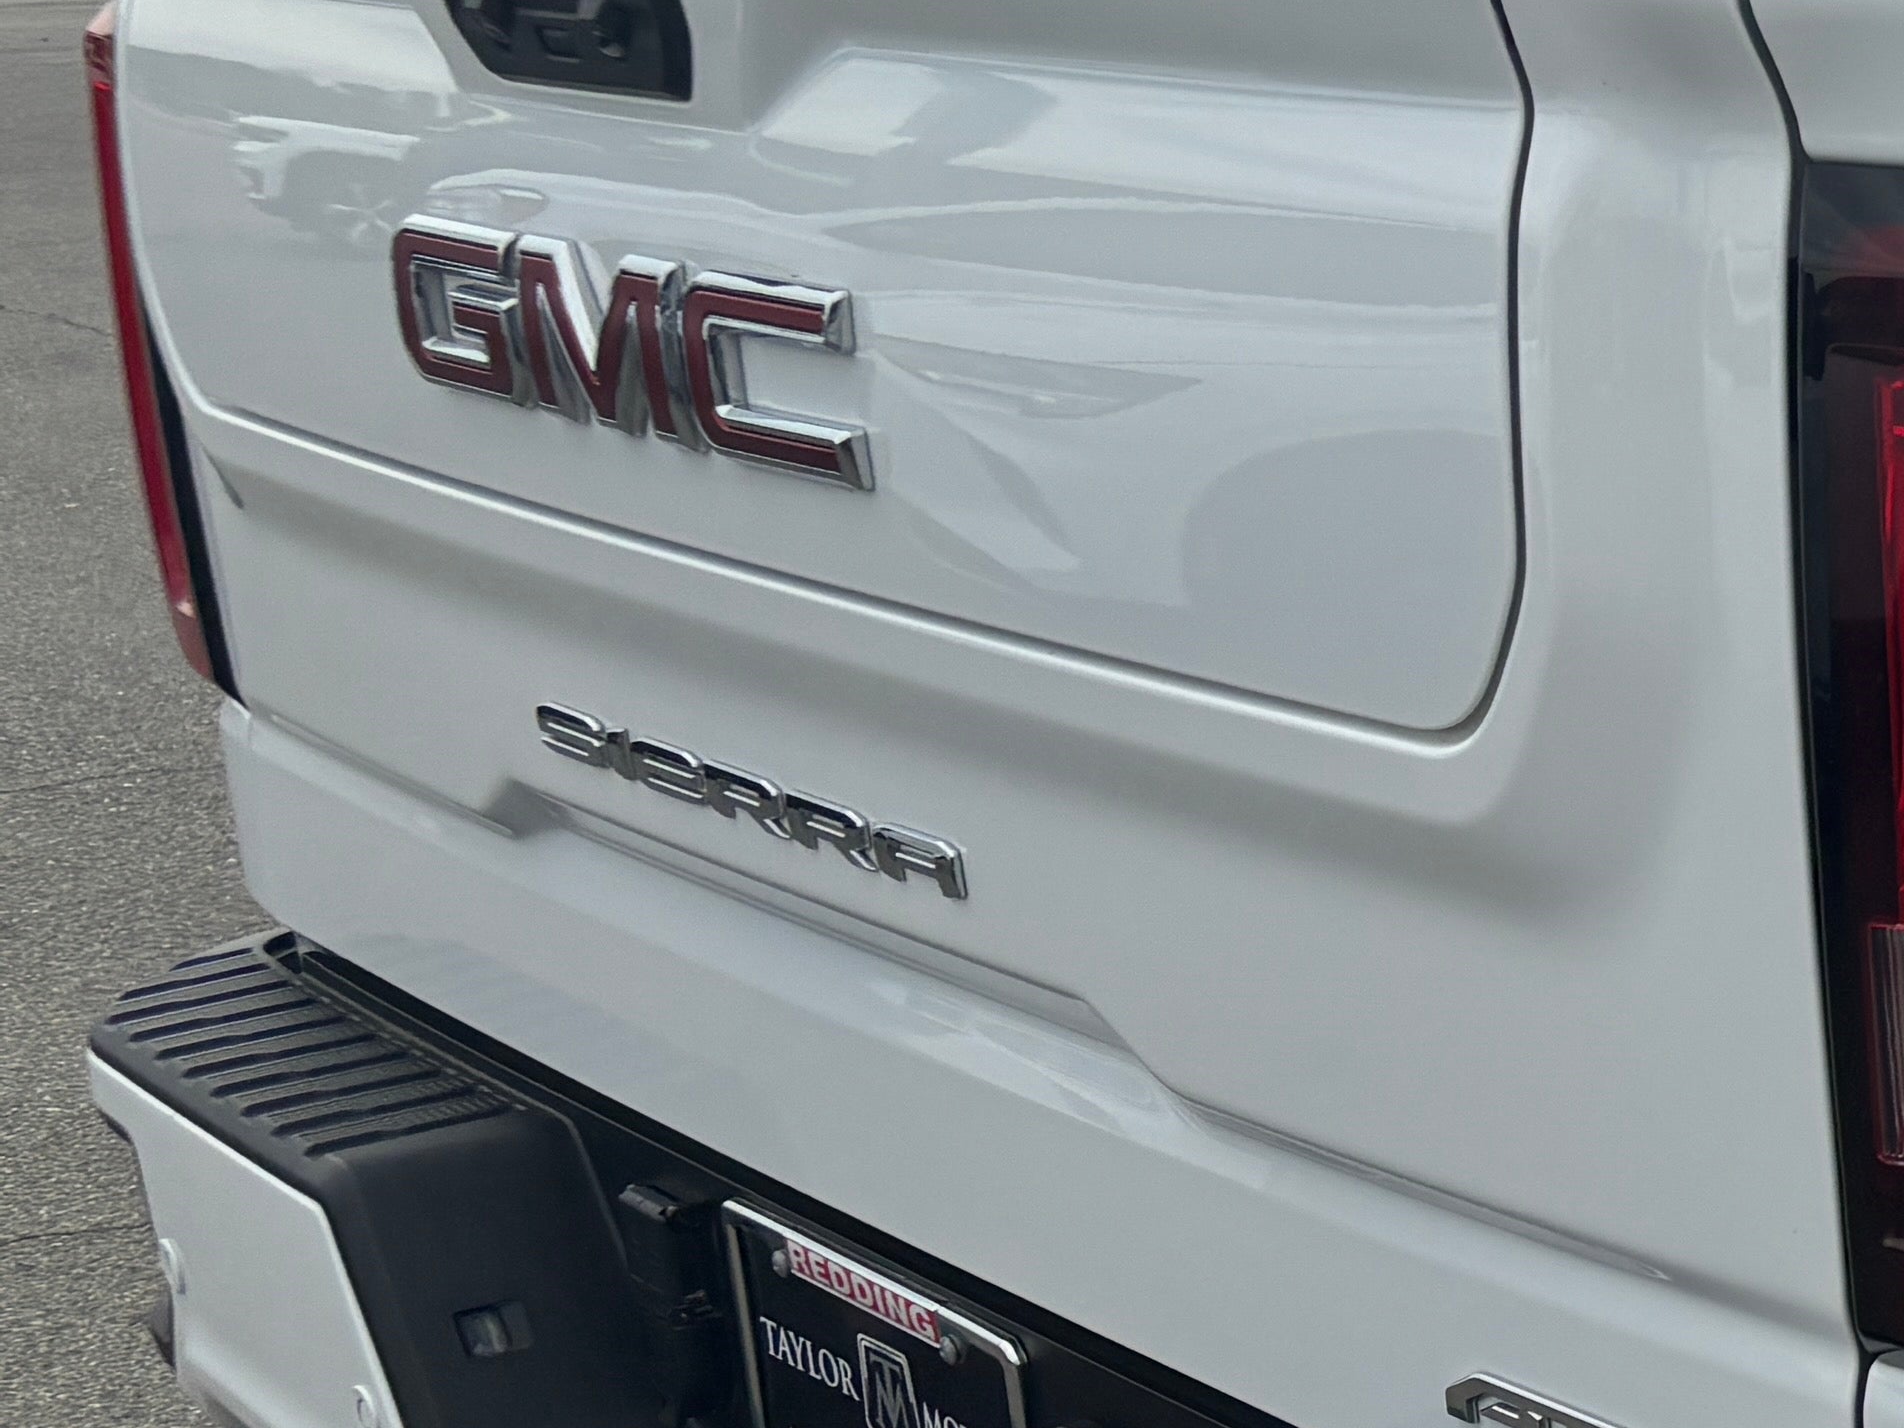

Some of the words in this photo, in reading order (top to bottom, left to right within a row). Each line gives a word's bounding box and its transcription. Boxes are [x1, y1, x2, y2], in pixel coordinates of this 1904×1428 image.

[391, 213, 876, 492] GMC
[535, 700, 968, 900] SIERRA
[760, 1316, 861, 1401] TAYLOR
[787, 1240, 936, 1340] REDDING
